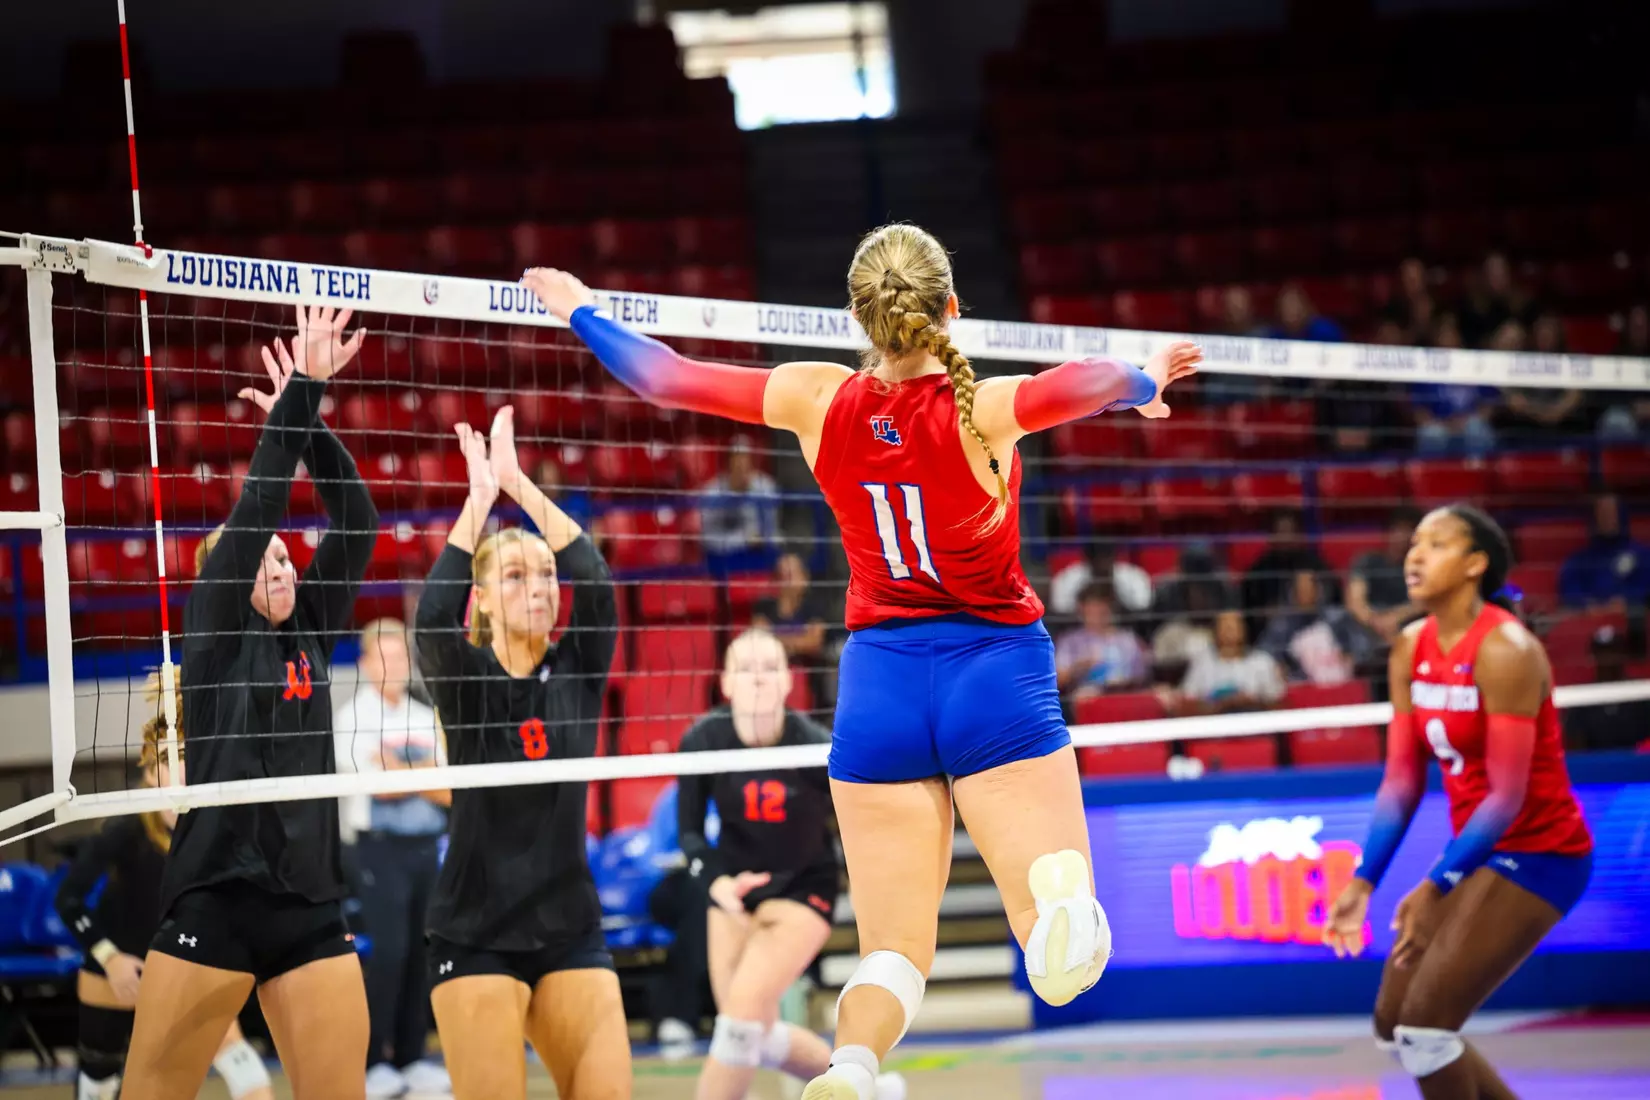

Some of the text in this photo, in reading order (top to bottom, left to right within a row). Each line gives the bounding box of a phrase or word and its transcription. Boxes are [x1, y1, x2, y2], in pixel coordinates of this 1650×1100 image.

[166, 252, 372, 300] LOUISIANA TECH
[489, 285, 659, 324] LOUIS TECH
[757, 308, 851, 338] LOUISIANA
[858, 481, 942, 586] 11
[518, 717, 549, 760] 8
[743, 779, 787, 823] 12
